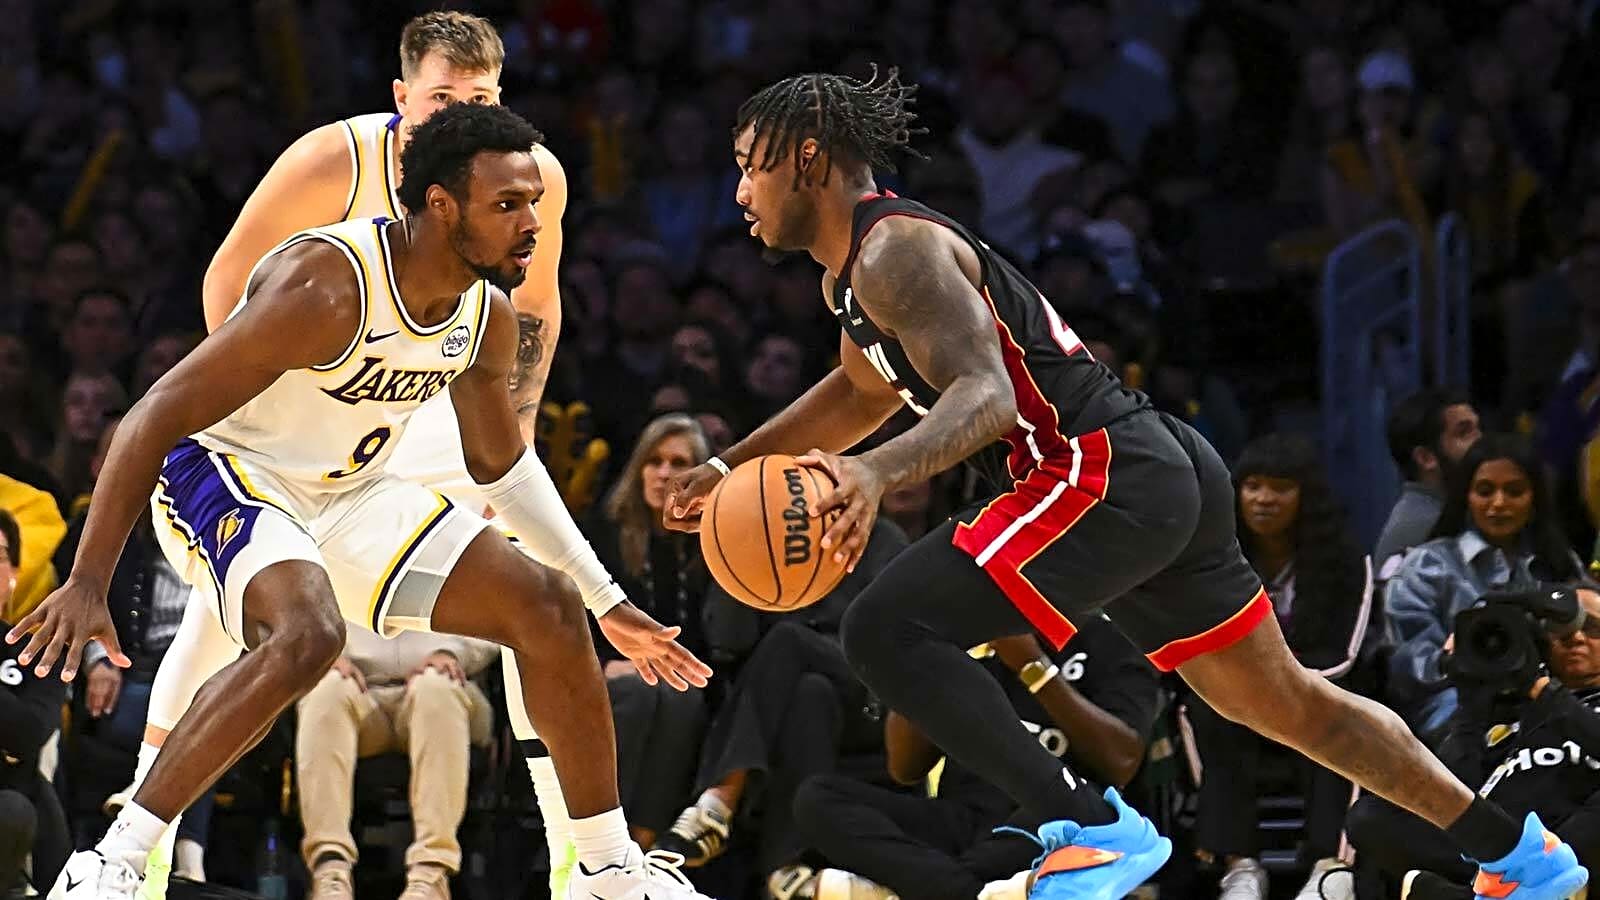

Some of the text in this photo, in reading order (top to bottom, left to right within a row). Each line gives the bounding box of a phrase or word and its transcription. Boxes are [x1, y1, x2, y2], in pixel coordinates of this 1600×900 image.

[320, 356, 457, 405] LAKERS
[326, 426, 391, 479] 9
[783, 468, 811, 567] Wilson
[1061, 652, 1089, 682] 6
